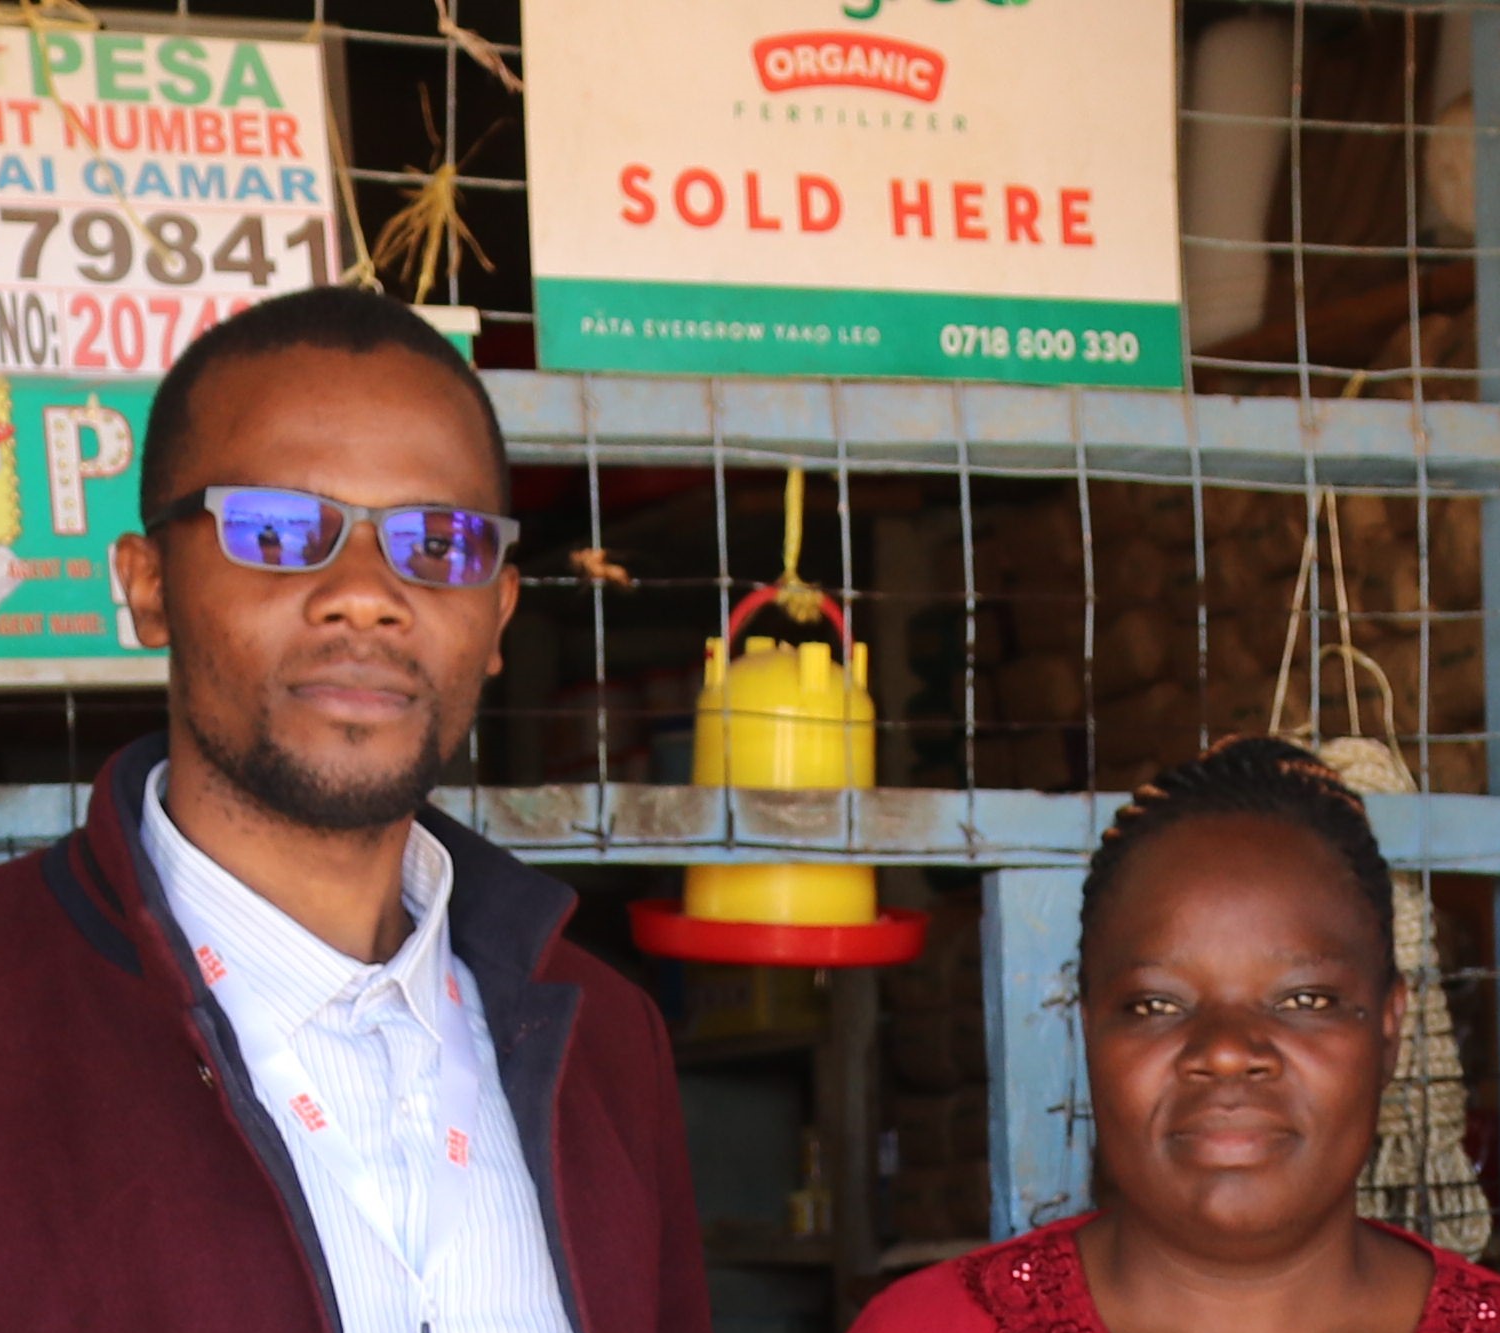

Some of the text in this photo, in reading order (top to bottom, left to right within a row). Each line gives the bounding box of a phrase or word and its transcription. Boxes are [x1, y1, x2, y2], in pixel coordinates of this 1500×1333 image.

[764, 43, 935, 91] ORGANIC
[65, 104, 303, 158] NUMBER
[732, 100, 968, 132] FERTILIZER
[617, 162, 1097, 247] SOLD HERE
[69, 293, 257, 371] 207
[642, 318, 767, 343] EVERGROW
[939, 323, 1011, 359] 0718
[1015, 326, 1078, 361] 800
[1082, 329, 1141, 364] 330
